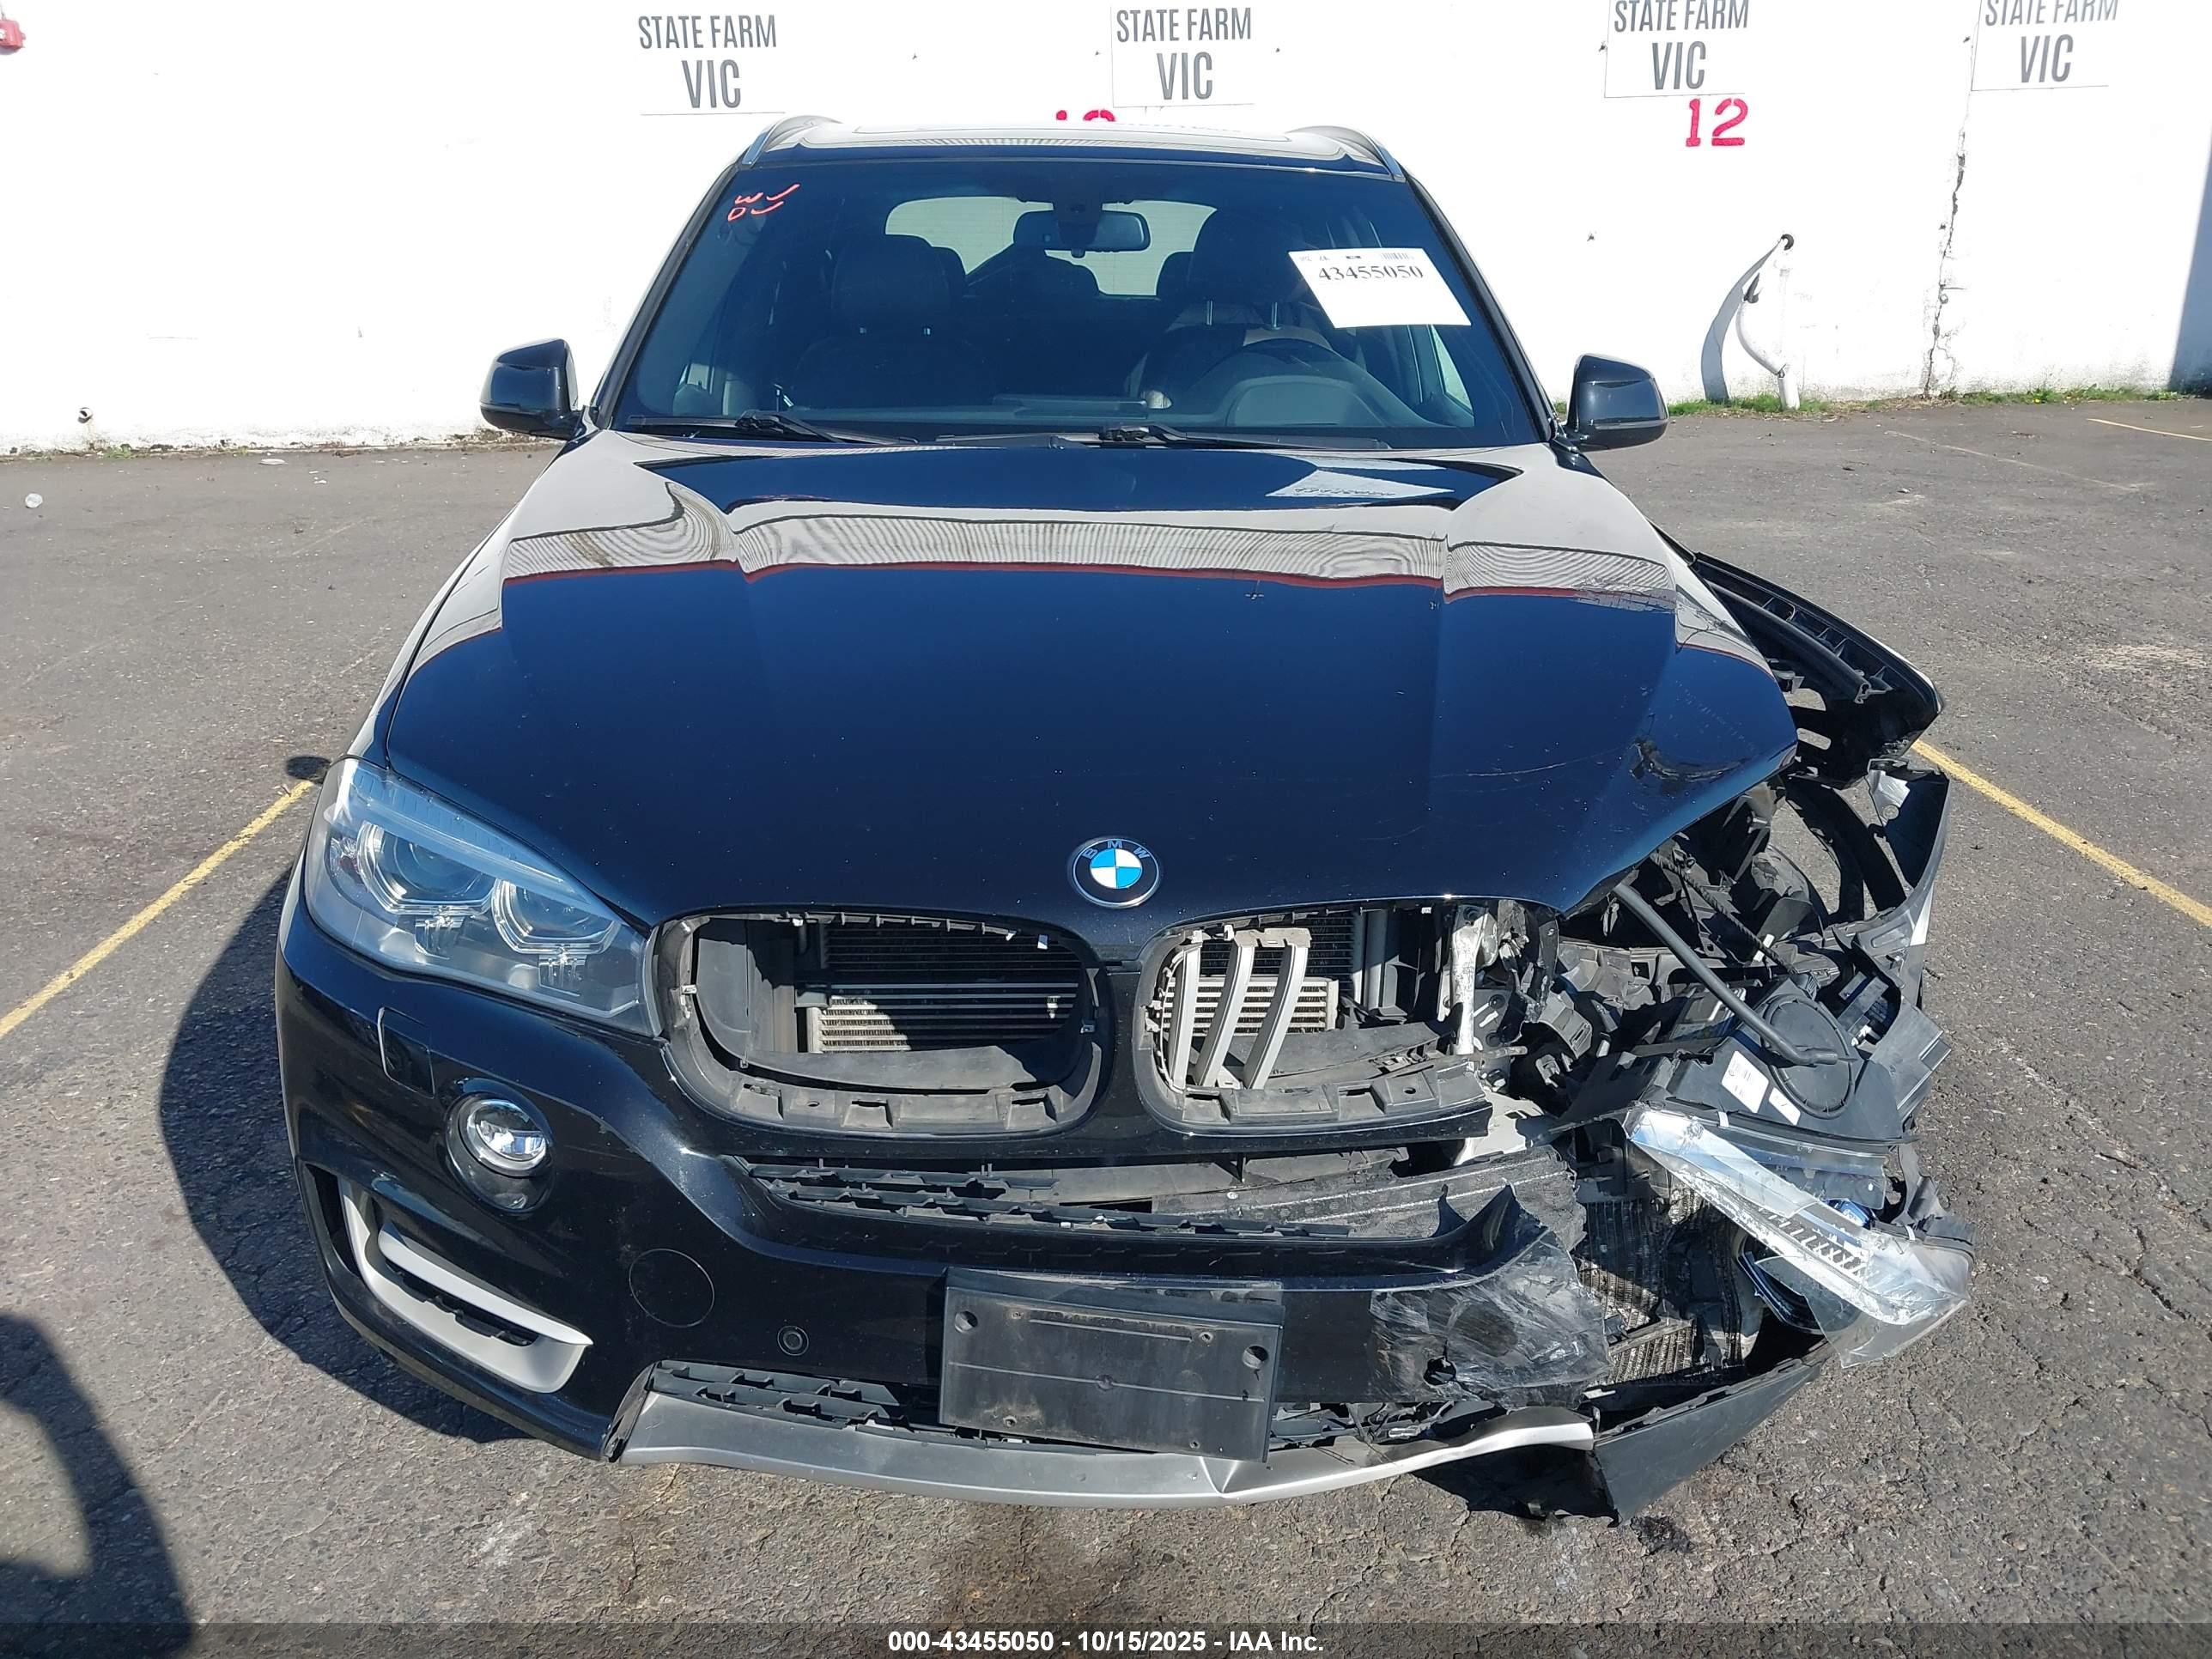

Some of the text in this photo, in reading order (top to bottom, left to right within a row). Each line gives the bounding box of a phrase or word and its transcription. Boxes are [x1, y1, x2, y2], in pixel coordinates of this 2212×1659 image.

[638, 15, 777, 50] STATE FARM
[1116, 8, 1251, 43] STATE FARM
[1613, 0, 1749, 33] STATE FARM
[1156, 52, 1213, 100] VIC
[1651, 41, 1707, 91] VIC
[2021, 34, 2074, 83] VIC
[681, 59, 742, 109] VIC
[1686, 98, 1749, 148] 12
[1319, 265, 1424, 281] 43455050
[1081, 840, 1150, 860] BMW
